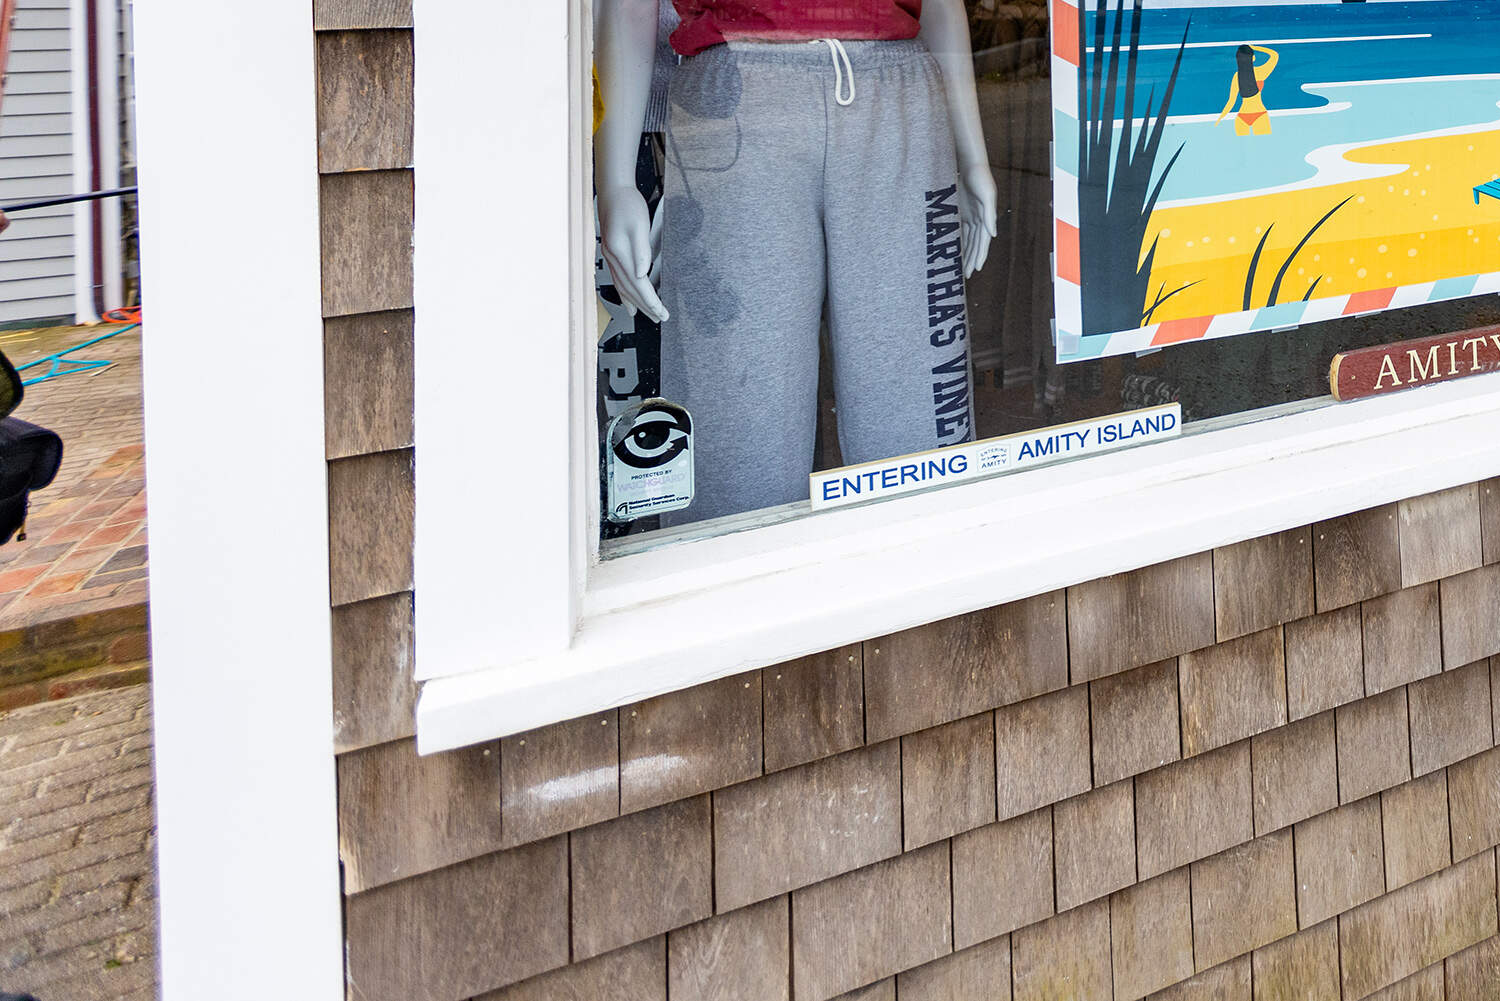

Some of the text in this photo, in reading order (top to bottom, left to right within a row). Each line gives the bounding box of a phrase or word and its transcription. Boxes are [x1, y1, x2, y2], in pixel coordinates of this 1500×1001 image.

[925, 184, 967, 348] MARTHA'S
[631, 472, 663, 480] PROTECTED
[823, 413, 1177, 500] ENTERING AMITY ISLAND
[981, 458, 1007, 469] AMITY
